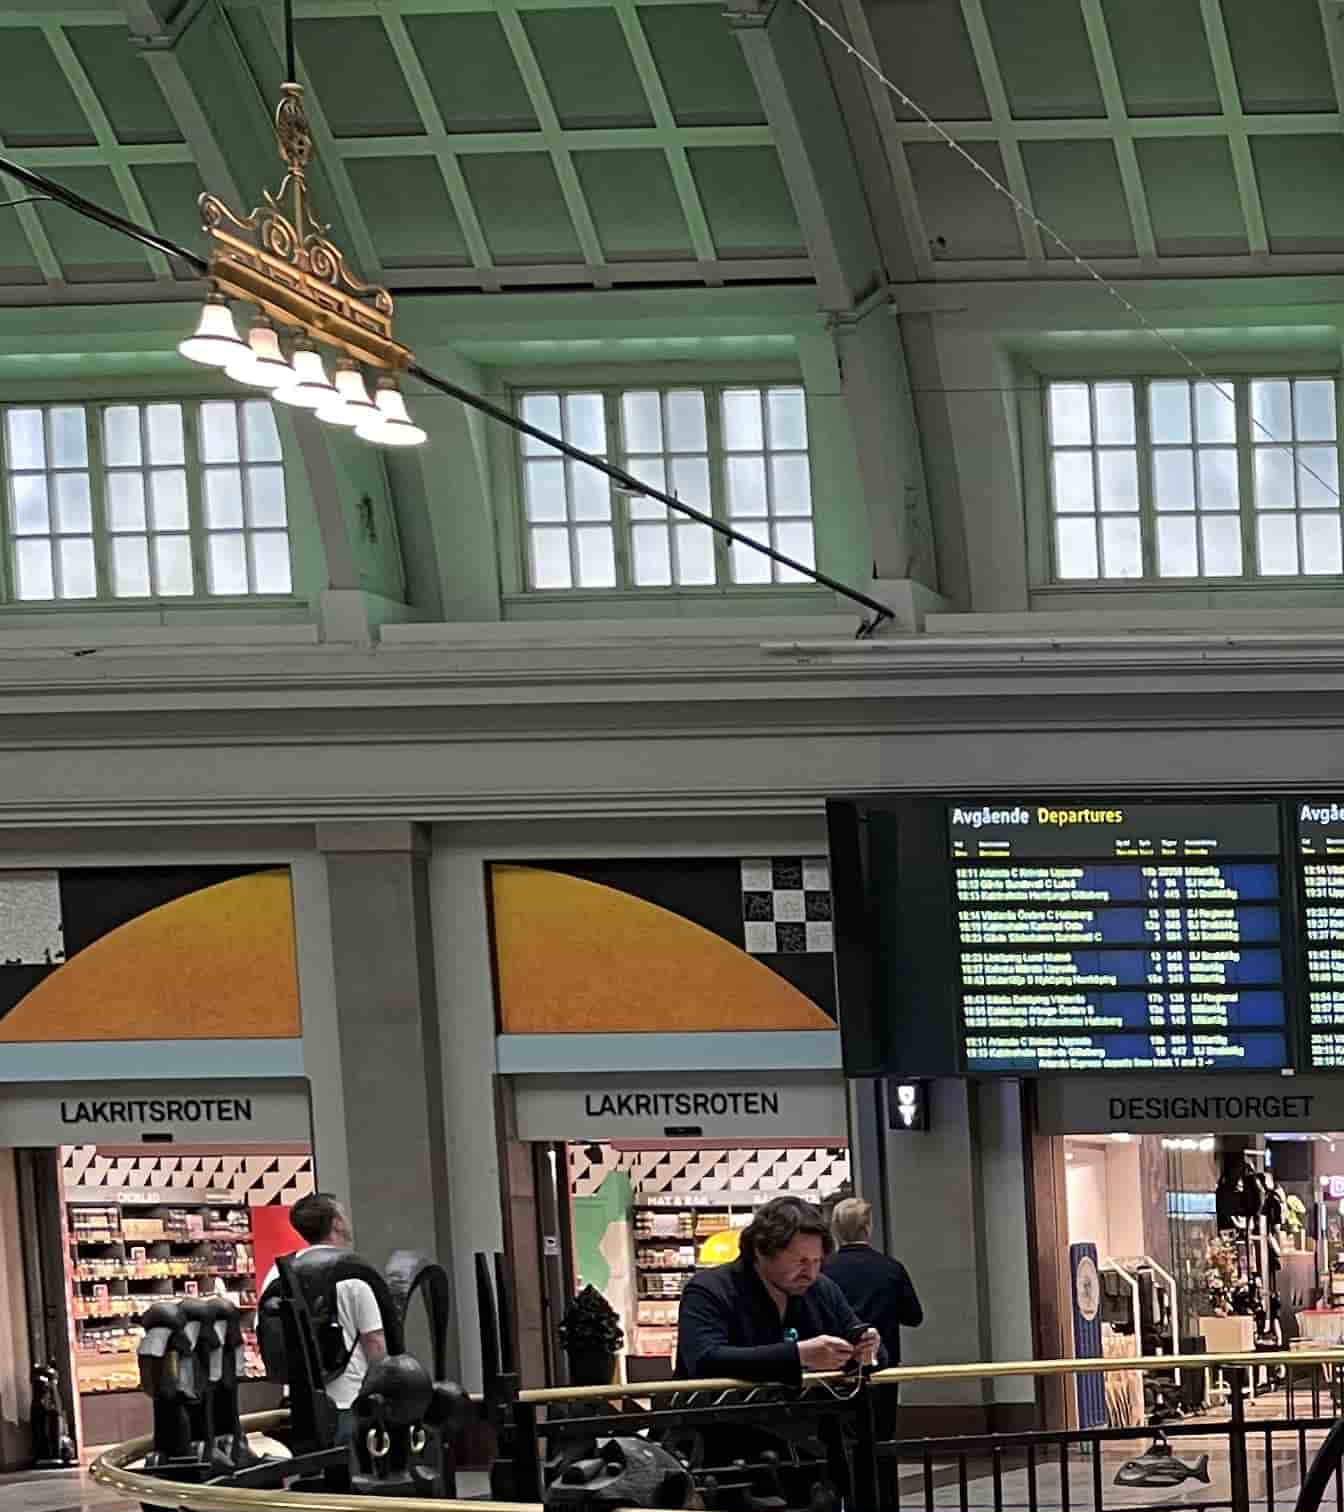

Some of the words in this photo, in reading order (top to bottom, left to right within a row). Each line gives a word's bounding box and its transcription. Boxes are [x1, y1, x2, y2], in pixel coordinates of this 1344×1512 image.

[952, 807, 1029, 828] Avgående
[1038, 808, 1122, 826] Departures
[59, 1098, 252, 1125] LAKRITSROTEN
[585, 1091, 779, 1116] LAKRITSROTEN
[1108, 1094, 1314, 1121] DESIGNTORGET
